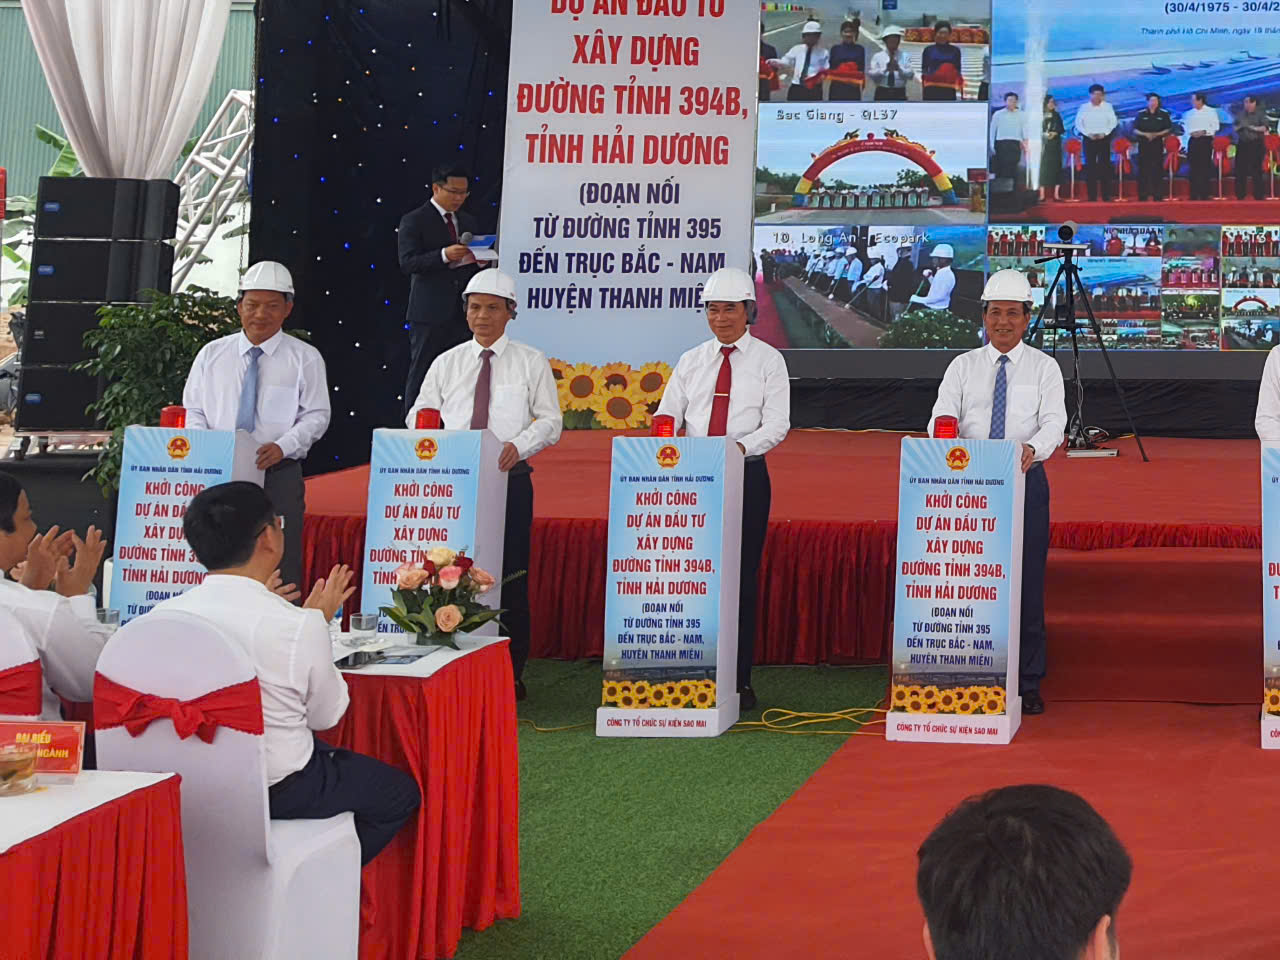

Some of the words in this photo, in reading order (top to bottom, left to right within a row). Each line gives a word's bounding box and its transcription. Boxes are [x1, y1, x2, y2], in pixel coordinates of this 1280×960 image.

[1165, 2, 1230, 15] (30/4/1975
[573, 29, 623, 64] XÂY
[631, 34, 699, 72] DỰNG
[517, 77, 604, 114] ĐƯỜNG
[614, 75, 671, 114] TỈNH
[679, 87, 748, 119] 394B,
[526, 124, 583, 163] TỈNH
[592, 124, 634, 164] HẢI
[643, 133, 729, 165] DƯƠNG
[580, 183, 640, 208] (ĐOẠN
[647, 176, 680, 204] NỐI
[534, 213, 559, 238] TỪ
[563, 213, 629, 238] ĐƯỜNG
[637, 211, 680, 238] TỈNH
[687, 218, 721, 238] 395
[519, 245, 558, 273] ĐẾN
[566, 252, 614, 278] TRỤC
[621, 244, 660, 273] BẮC
[528, 283, 592, 313] HUYỆN
[599, 288, 662, 309] THANH
[669, 283, 704, 313] MIỆ
[636, 488, 662, 505] KHỞI
[666, 489, 697, 505] CÔNG
[925, 490, 952, 508] KHỞI
[956, 491, 987, 508] CÔNG
